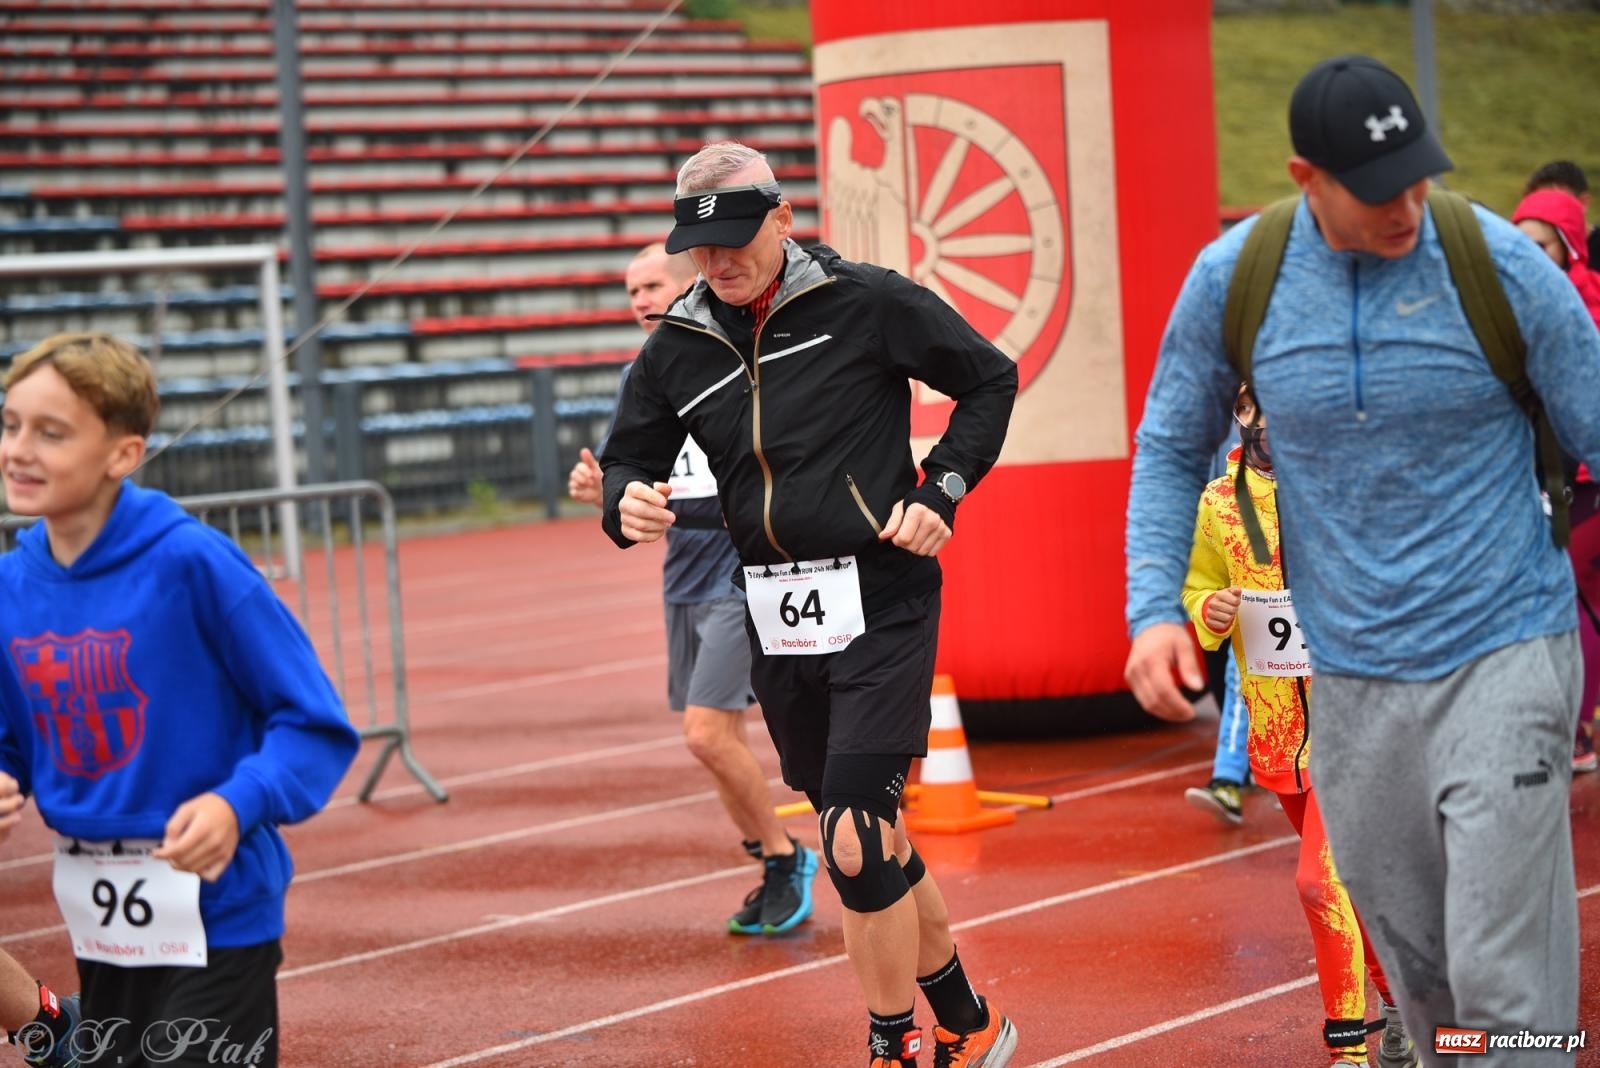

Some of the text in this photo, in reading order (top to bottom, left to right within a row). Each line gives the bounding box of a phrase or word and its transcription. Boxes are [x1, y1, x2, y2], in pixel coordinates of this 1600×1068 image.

[779, 589, 825, 628] 64
[781, 634, 853, 649] Racibórz OSiR
[92, 878, 154, 928] 96
